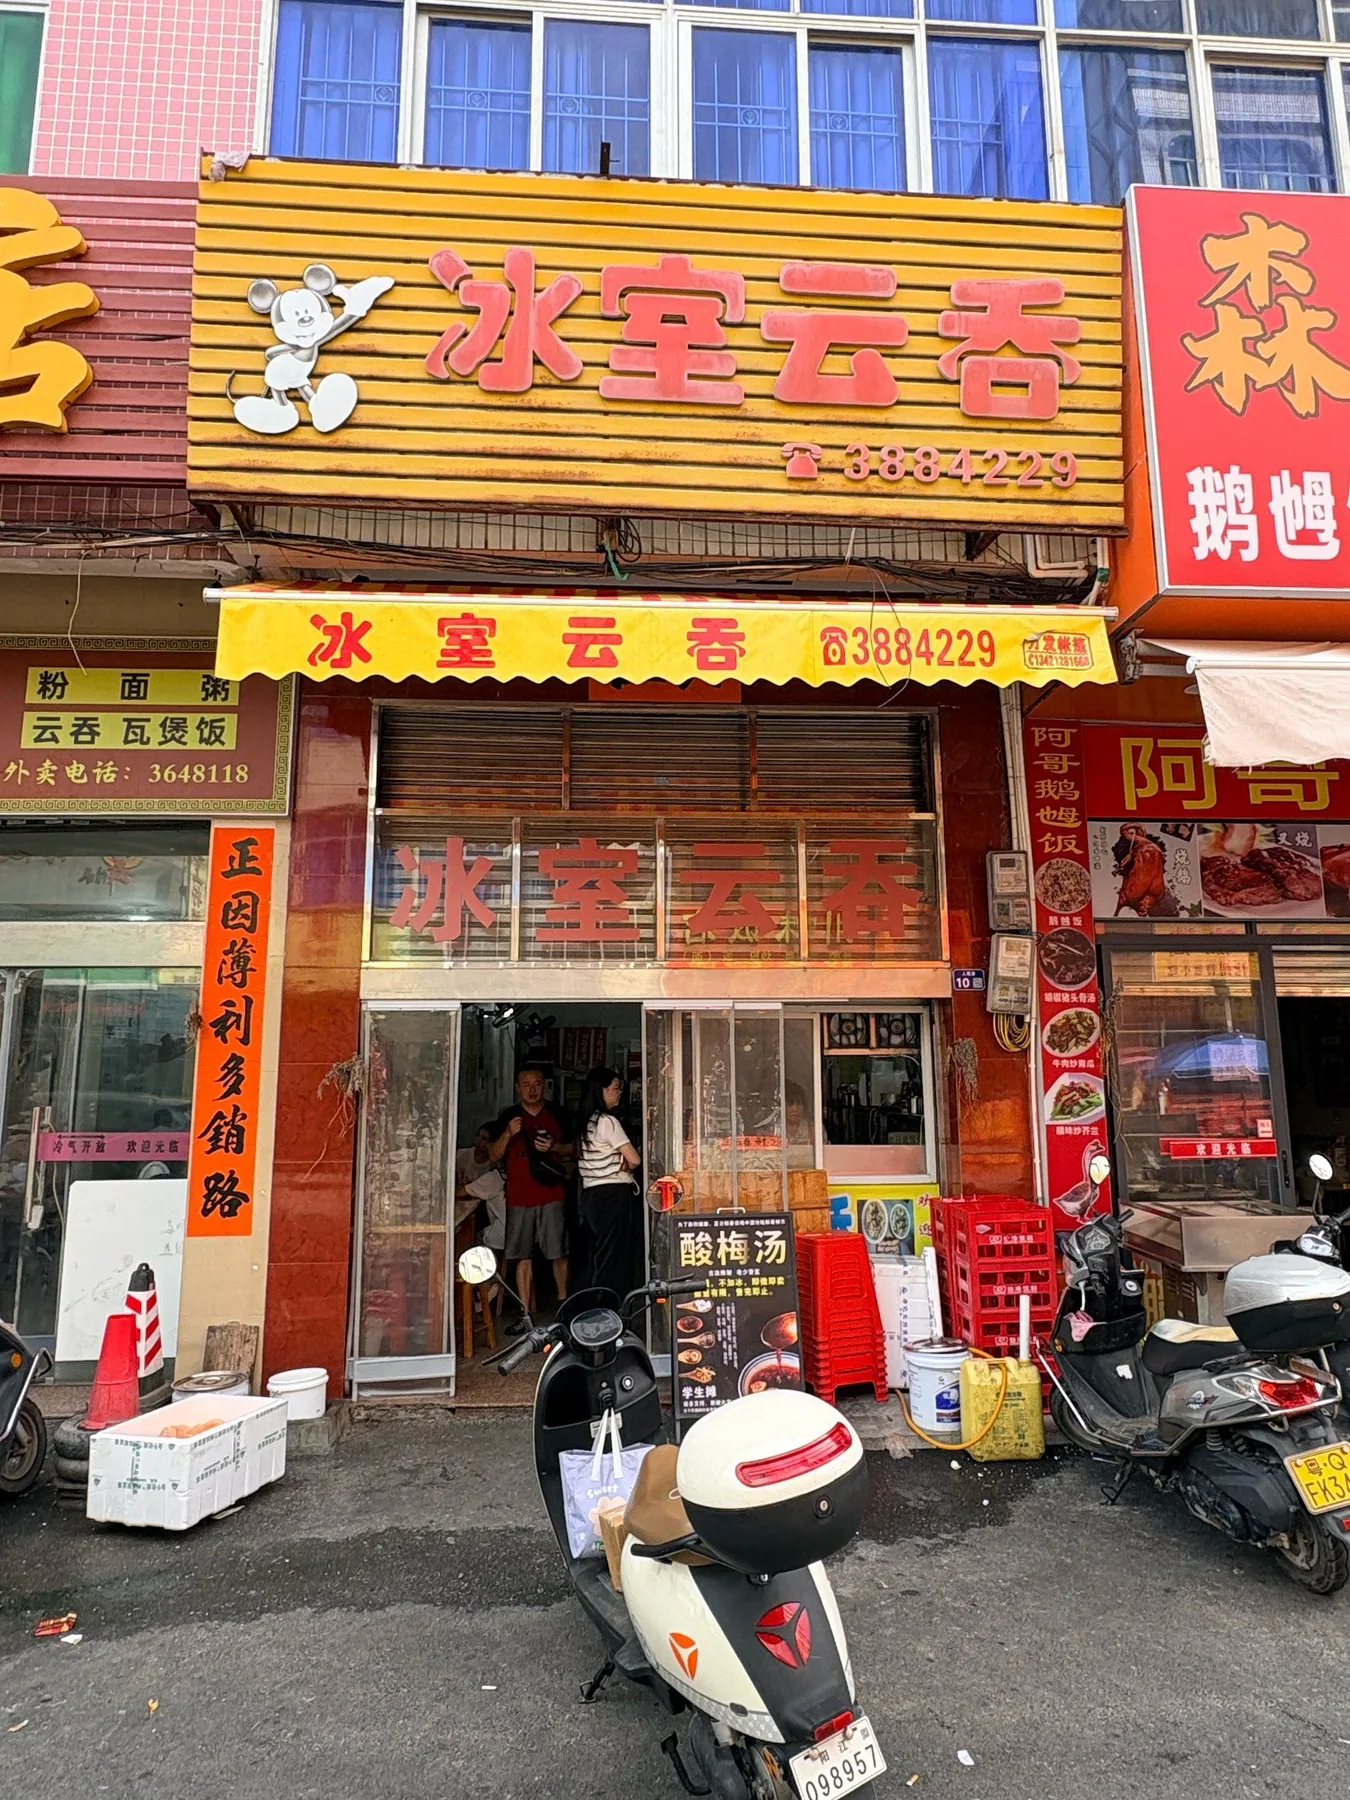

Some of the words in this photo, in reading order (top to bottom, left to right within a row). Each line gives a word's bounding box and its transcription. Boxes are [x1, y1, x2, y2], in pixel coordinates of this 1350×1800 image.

[425, 247, 1081, 421] 冰室云吞
[1180, 211, 1350, 420] 森
[843, 442, 1078, 488] 3884229
[308, 611, 746, 670] 冰室云吞
[853, 627, 995, 667] 3884229
[149, 763, 249, 784] 3648118
[389, 837, 924, 943] 冰室云吞
[956, 977, 970, 988] 10
[52, 1140, 107, 1154] 冷气开放
[127, 1140, 179, 1154] 欢迎光临
[1196, 1143, 1252, 1156] 欢迎光临
[679, 1230, 787, 1268] 酸梅汤
[805, 1743, 877, 1800] 098957
